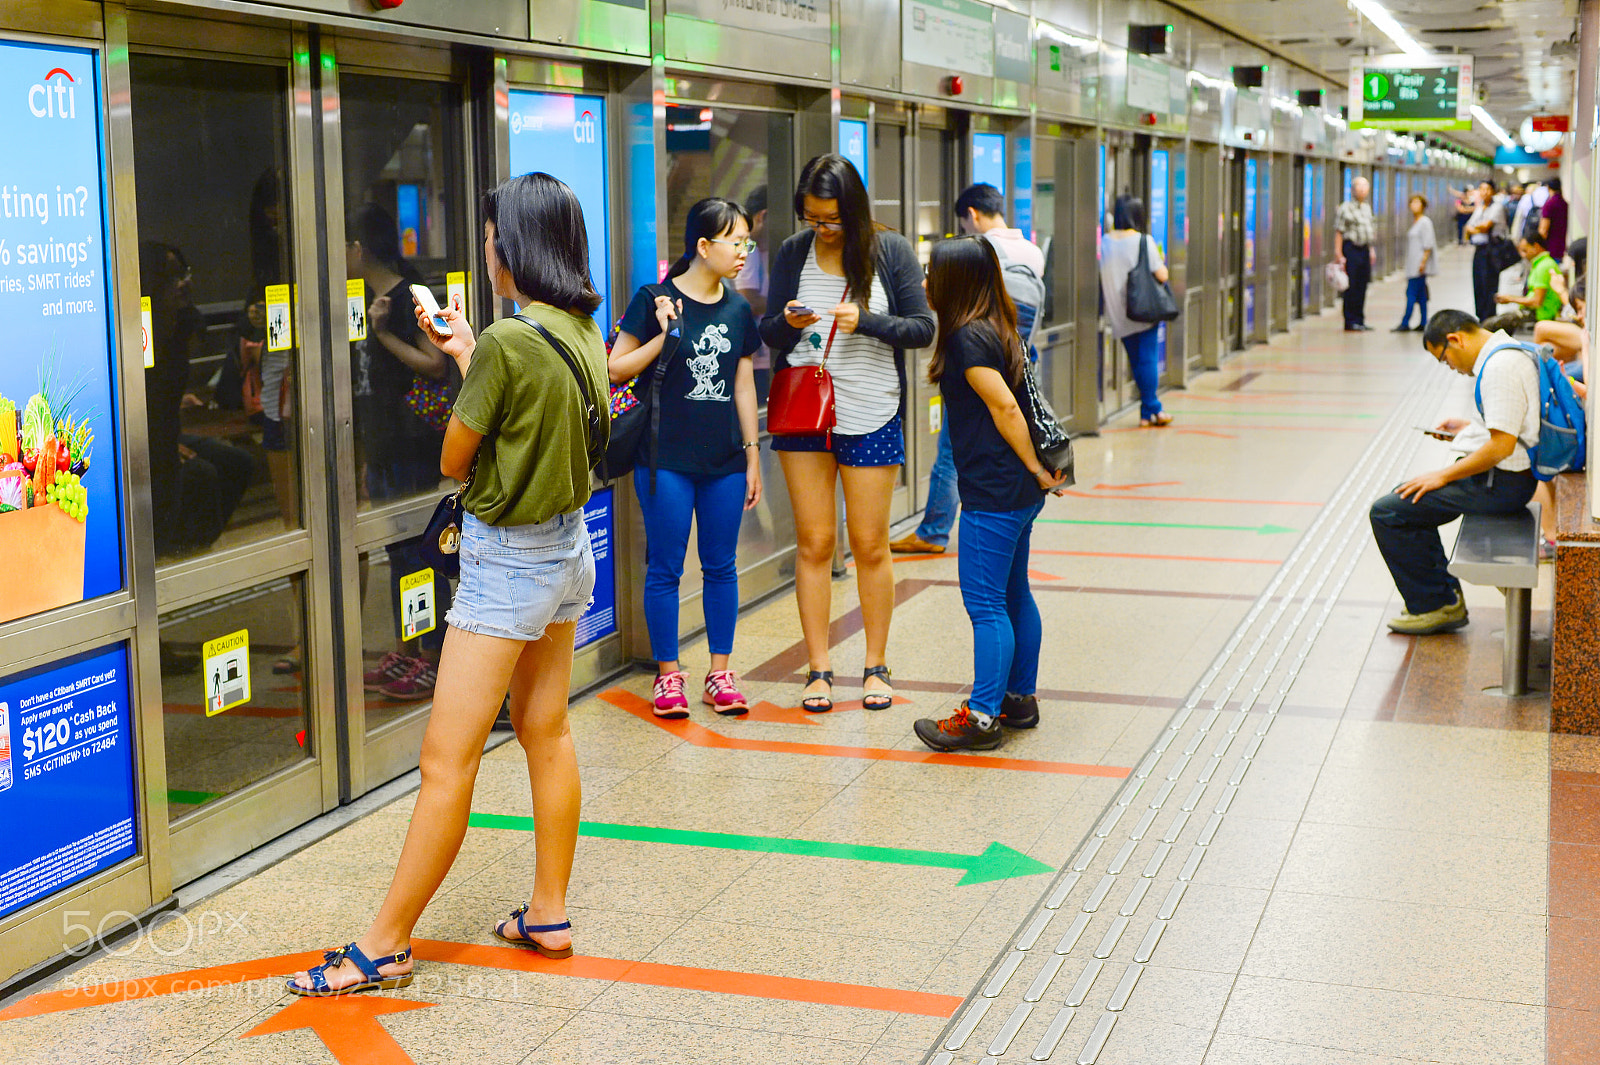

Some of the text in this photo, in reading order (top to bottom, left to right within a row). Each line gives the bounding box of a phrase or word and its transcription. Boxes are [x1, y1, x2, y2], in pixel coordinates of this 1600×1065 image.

[28, 68, 76, 119] citi
[1366, 76, 1379, 98] 1
[1433, 77, 1447, 95] 2
[574, 110, 595, 144] citi
[0, 185, 88, 225] ting in?
[28, 272, 61, 291] SMRT
[42, 299, 97, 316] and more.
[216, 634, 244, 652] CAUTION
[20, 695, 35, 709] Don't
[36, 693, 49, 704] have
[53, 683, 75, 698] Citibank
[76, 677, 91, 689] SMRT
[91, 673, 104, 685] Card
[104, 668, 116, 683] yet?
[21, 700, 74, 726] Apply now and get
[73, 708, 95, 726] Cash
[96, 700, 117, 719] Back
[74, 715, 118, 740] as you spend
[24, 764, 42, 780] SMS
[82, 746, 91, 758] to
